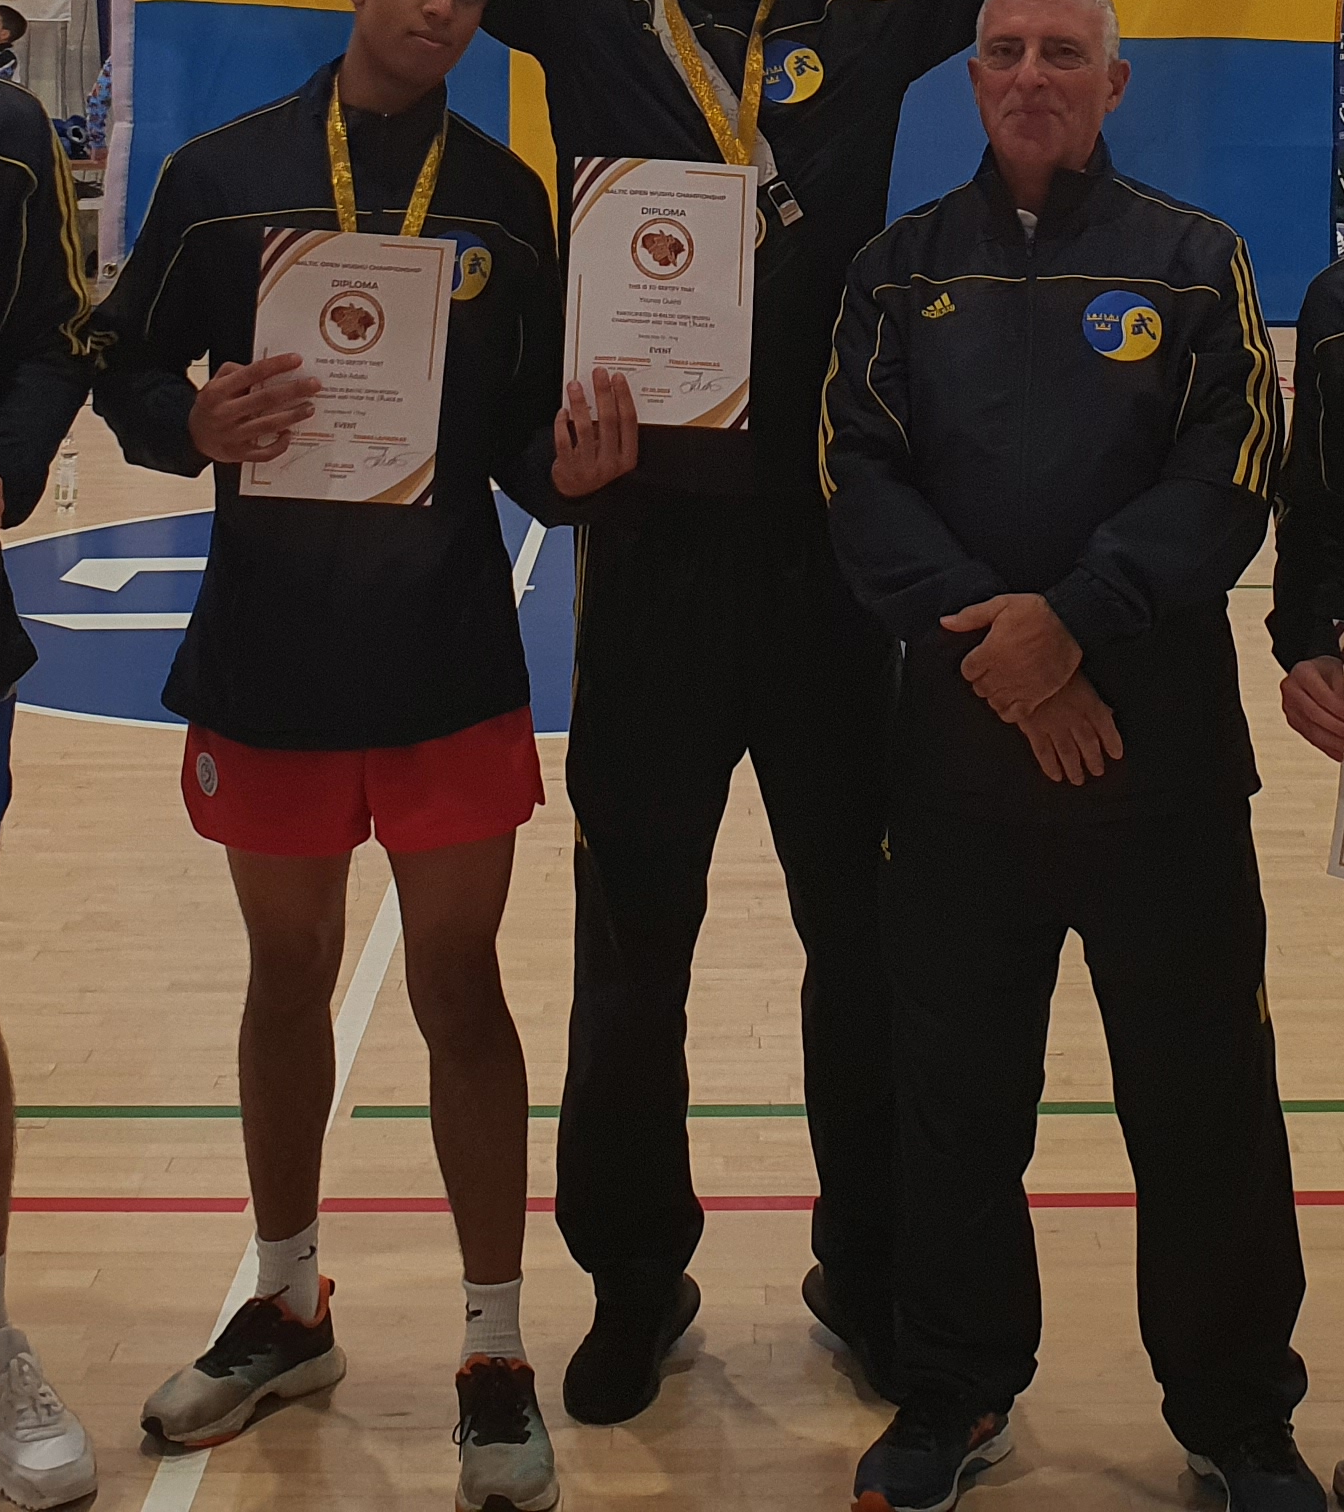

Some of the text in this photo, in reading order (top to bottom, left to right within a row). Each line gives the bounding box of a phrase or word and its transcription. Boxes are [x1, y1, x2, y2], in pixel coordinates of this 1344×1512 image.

[641, 207, 686, 217] DIPLOMA
[331, 279, 379, 289] DIPLOMA
[649, 347, 672, 355] EVENT
